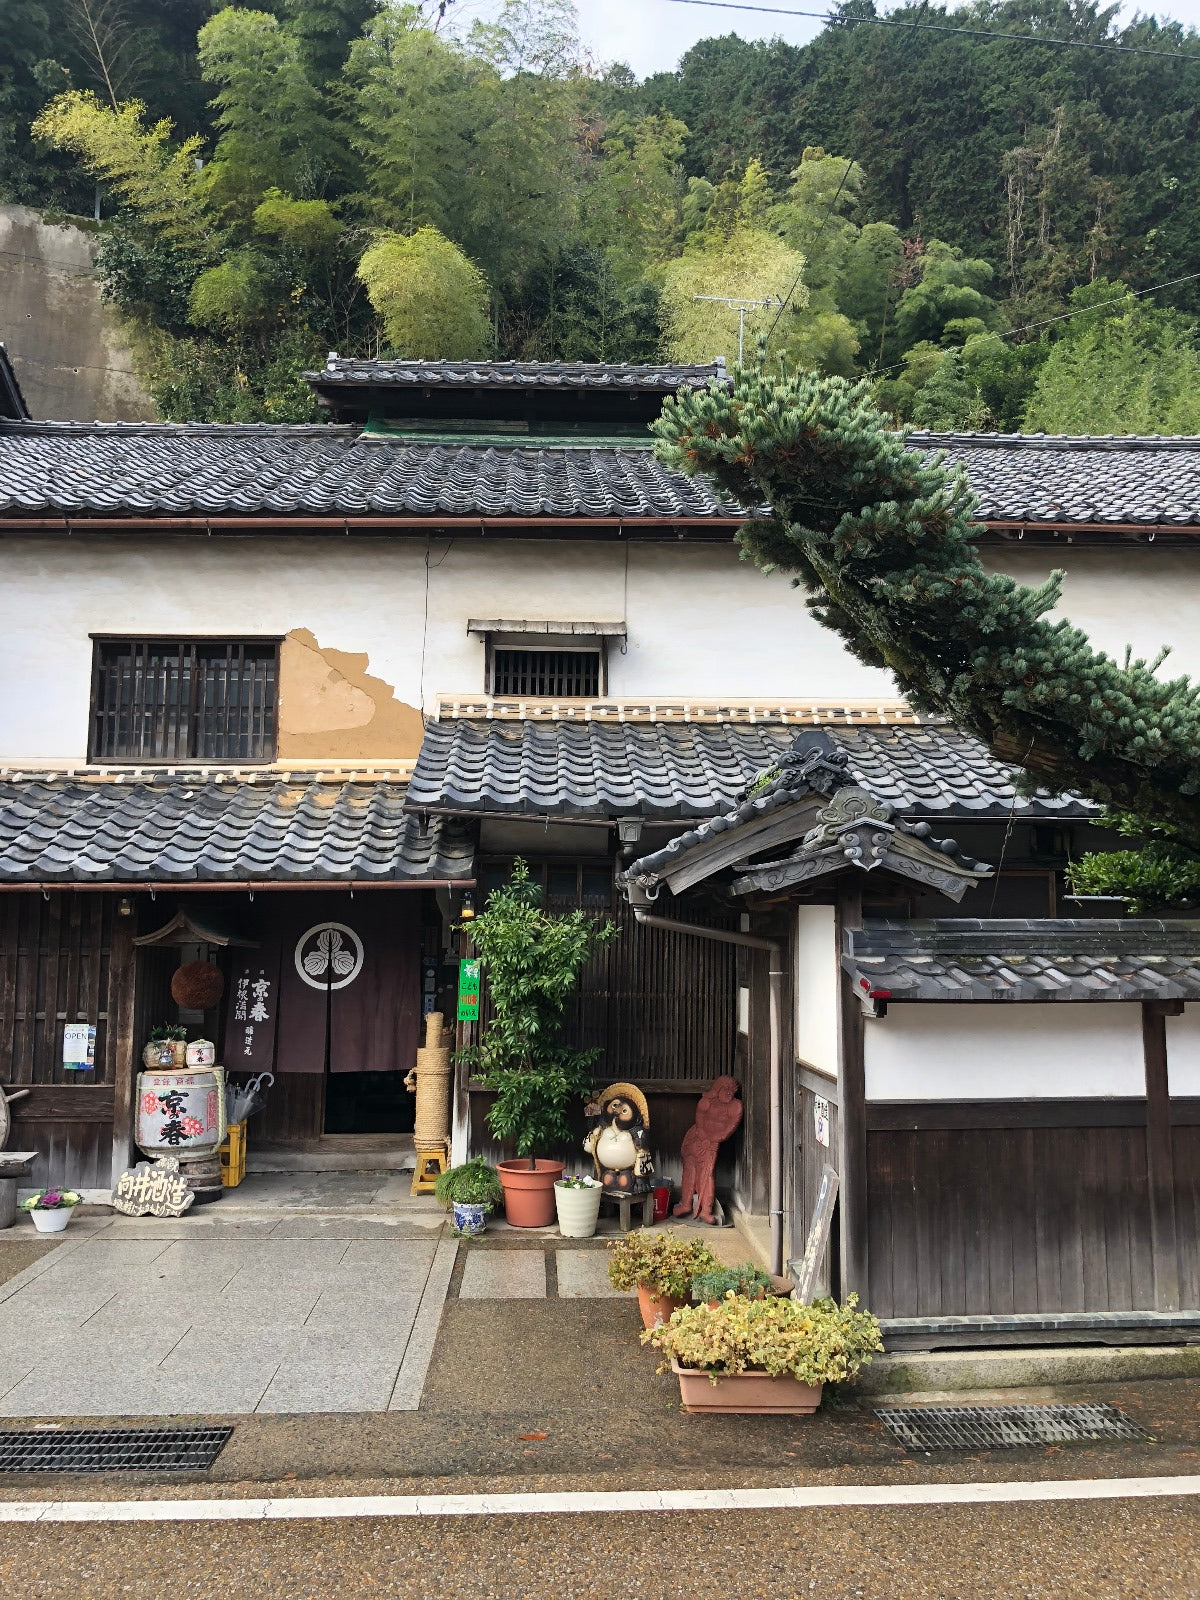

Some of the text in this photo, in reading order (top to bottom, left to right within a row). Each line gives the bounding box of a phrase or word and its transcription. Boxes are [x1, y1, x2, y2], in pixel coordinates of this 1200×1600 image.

[461, 982, 478, 991] こども
[248, 978, 271, 1022] 京の春
[460, 1008, 477, 1017] のいえ
[64, 1032, 87, 1040] OPEN
[158, 1089, 190, 1146] 京の春
[117, 1166, 196, 1211] 向井酒造
